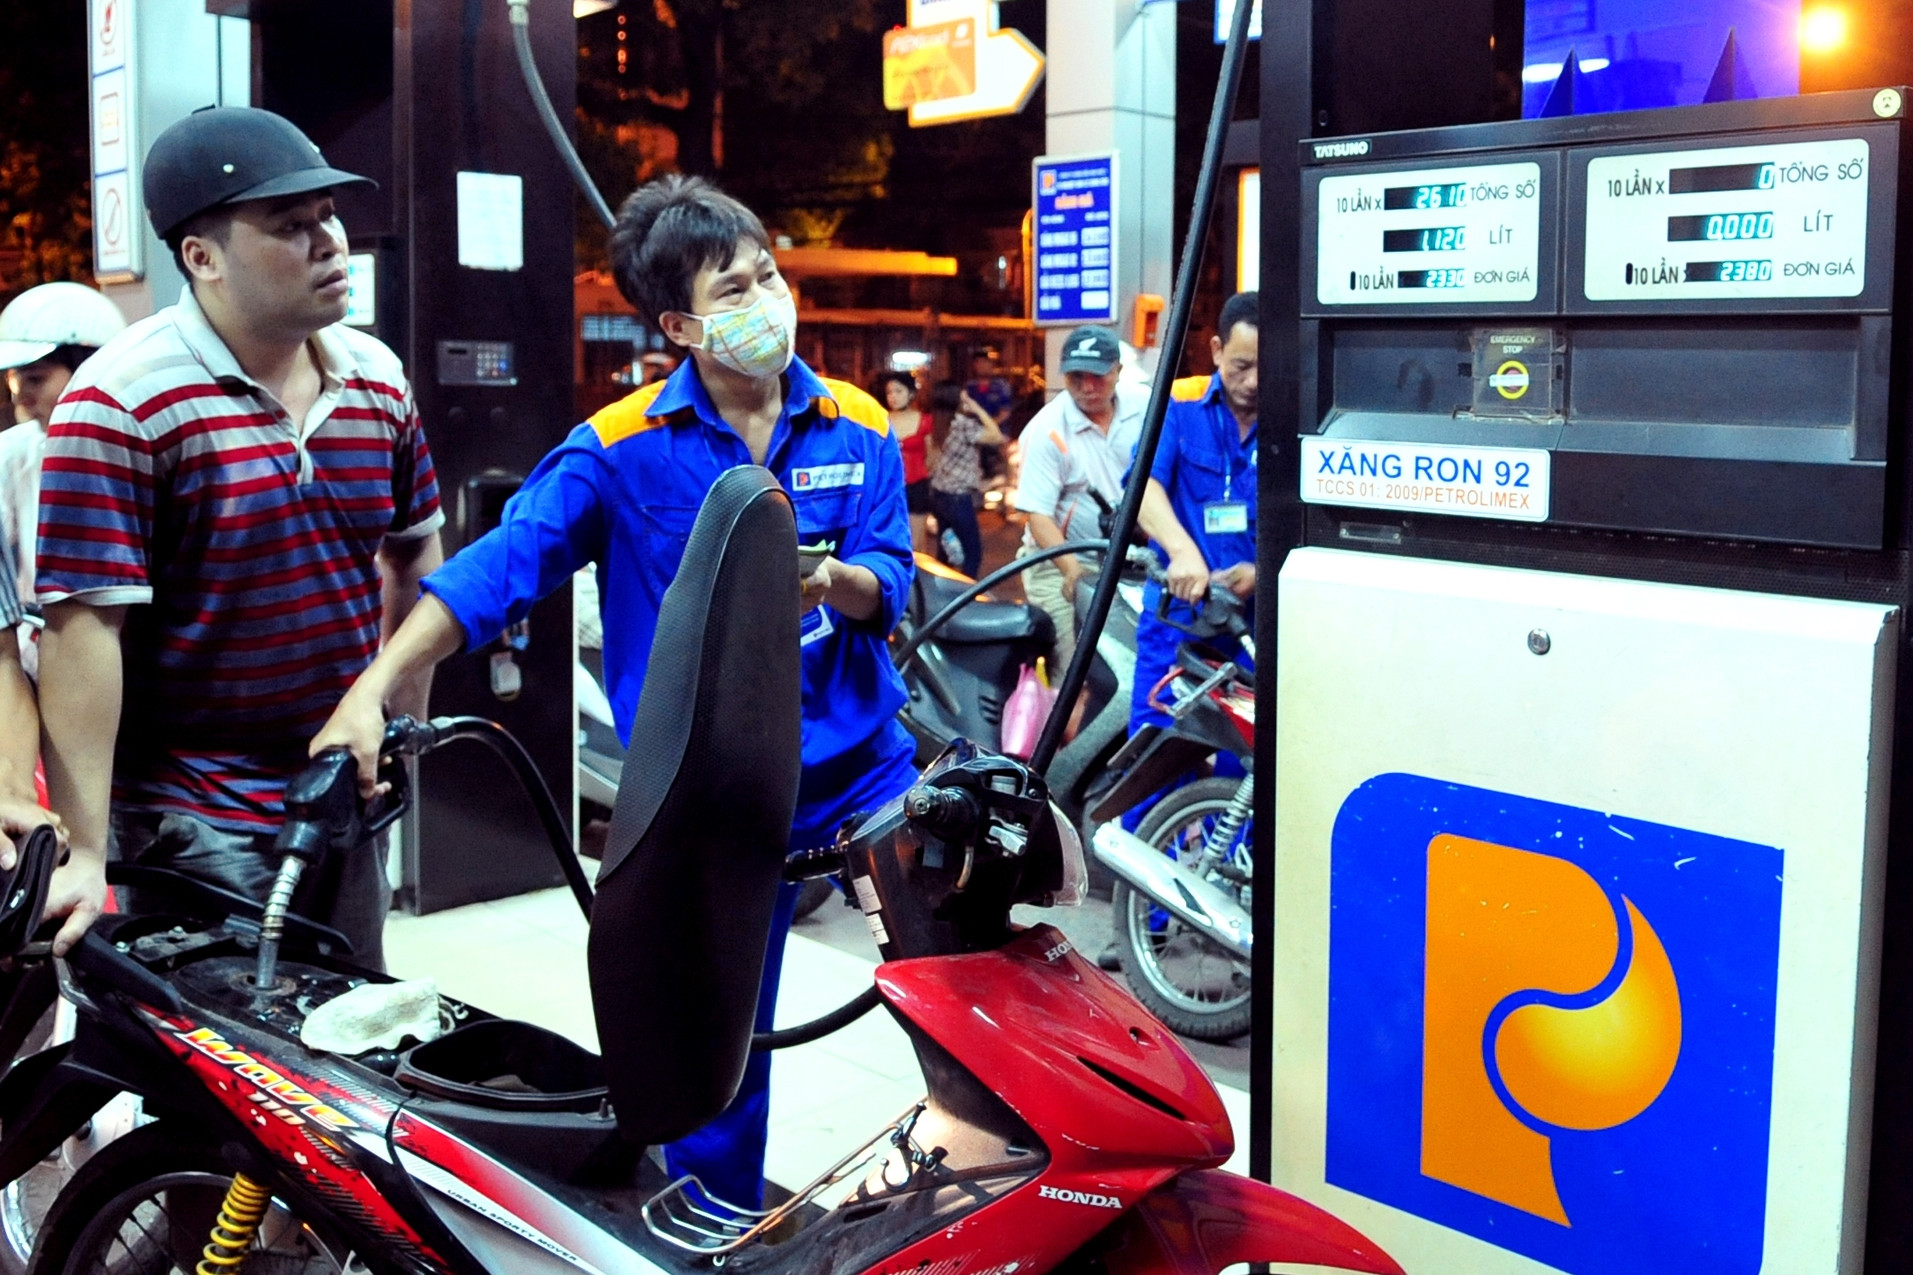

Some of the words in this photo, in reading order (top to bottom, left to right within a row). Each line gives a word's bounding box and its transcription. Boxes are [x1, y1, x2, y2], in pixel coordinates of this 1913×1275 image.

[1314, 141, 1369, 158] TATSUNO
[1608, 179, 1622, 197] 10
[1625, 169, 1652, 196] LẦN
[1758, 164, 1775, 189] 0
[1779, 161, 1829, 184] TỔNG
[1837, 158, 1864, 181] SỐ
[1336, 198, 1348, 213] 10
[1351, 187, 1372, 211] LẦN
[1416, 185, 1466, 209] 2610
[1470, 181, 1509, 202] TỔNG
[1515, 179, 1537, 199] SỐ
[1803, 209, 1834, 233] LÍT
[1489, 224, 1513, 245] LÍT
[1358, 274, 1370, 290] 10
[1373, 266, 1394, 289] LẦN
[1506, 267, 1530, 283] GIÁ
[1633, 268, 1648, 285] 10
[1652, 257, 1679, 284] LẦN
[1720, 261, 1772, 281] 2380
[1825, 258, 1855, 276] GIÁ
[1490, 335, 1535, 344] EMERGENCY
[1503, 345, 1523, 354] STOP
[1318, 445, 1402, 479] XĂNG
[1414, 456, 1482, 485] RON
[1495, 461, 1530, 488] 92
[1317, 479, 1354, 496] TCCS
[1386, 484, 1530, 509] 2009/PETROLIMEX
[248, 1091, 306, 1126] 110
[1038, 1185, 1122, 1208] HONDA
[447, 1189, 487, 1213] URBAN
[490, 1212, 535, 1238] SPORTY
[537, 1238, 577, 1262] MOVER
